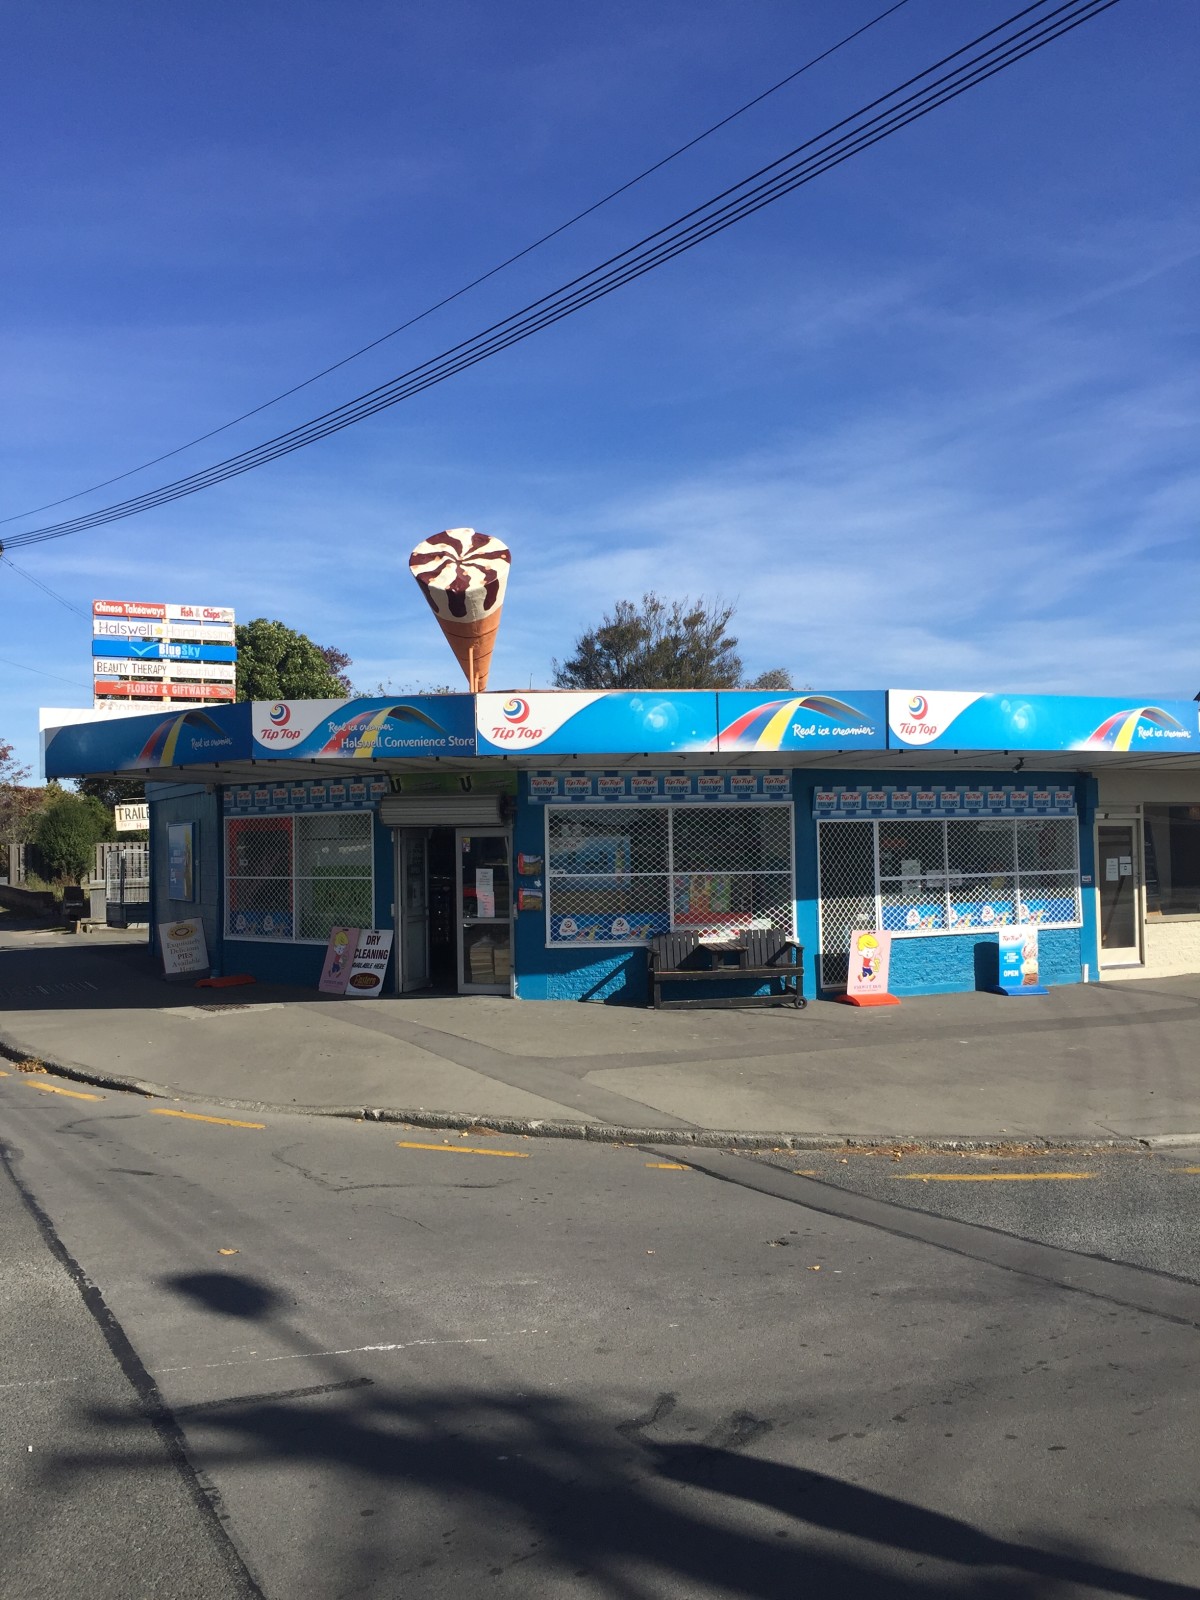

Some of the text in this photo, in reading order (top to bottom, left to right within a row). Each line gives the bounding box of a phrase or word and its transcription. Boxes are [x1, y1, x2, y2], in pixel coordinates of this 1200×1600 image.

[95, 602, 165, 616] Chinese Takeaways
[180, 608, 194, 617] Fish
[202, 608, 221, 620] Chips
[99, 622, 153, 636] Halswell
[96, 662, 167, 675] BEAUTY THERAPY
[176, 666, 234, 678] Beautiful You
[126, 684, 211, 696] FLORIST & GIFTWARE
[261, 728, 300, 740] Tip Top
[328, 722, 346, 734] Real
[492, 726, 542, 740] Tip Top
[792, 724, 874, 738] Real ice creamier
[900, 722, 937, 736] Tip Top
[1137, 726, 1154, 740] Real
[1154, 728, 1163, 737] ice
[191, 737, 203, 750] Real
[342, 736, 475, 748] Halswell Convenience Store
[366, 935, 382, 946] DRY
[177, 952, 193, 960] PIES
[354, 948, 388, 960] CLEANING
[172, 958, 200, 968] Available
